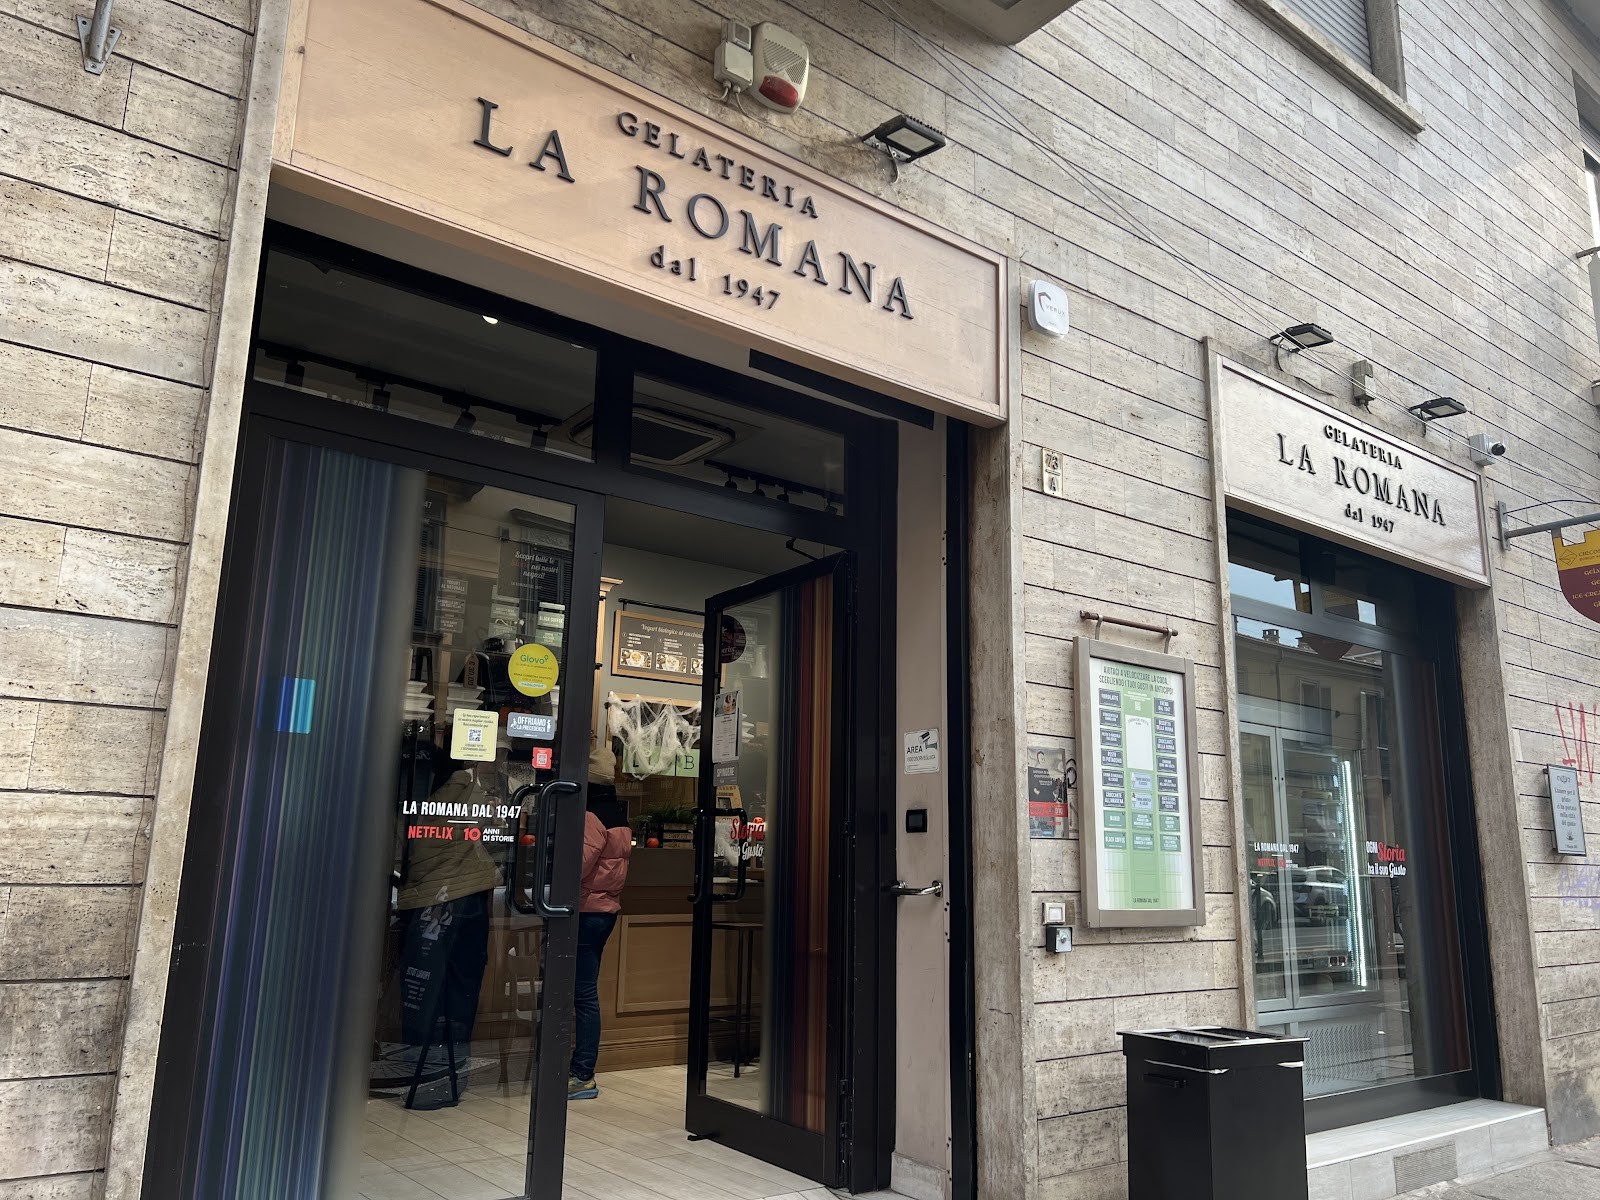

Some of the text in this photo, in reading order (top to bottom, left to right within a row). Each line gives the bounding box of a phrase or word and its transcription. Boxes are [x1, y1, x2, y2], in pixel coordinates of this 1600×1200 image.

[616, 111, 818, 219] GELATERIA
[473, 96, 914, 319] LA ROMANA
[650, 245, 781, 311] dal 1947
[1324, 424, 1403, 470] GELATERIA
[1277, 433, 1447, 527] LA ROMANA
[1344, 505, 1395, 533] dal 1947
[520, 655, 545, 665] Glovo
[517, 716, 547, 727] OFFRIAMO
[523, 725, 546, 733] PRECEDENZA
[906, 745, 923, 754] AREA
[403, 800, 522, 819] LA ROMANA DAL 1947
[408, 825, 454, 841] NETFLIX
[463, 827, 481, 841] 10
[730, 818, 766, 841] Storia
[742, 842, 764, 860] Gusto
[1254, 842, 1299, 854] LA ROMANA DAL 1947
[1366, 841, 1406, 862] OGNI Storia
[1368, 862, 1406, 878] ha il suo Gusto
